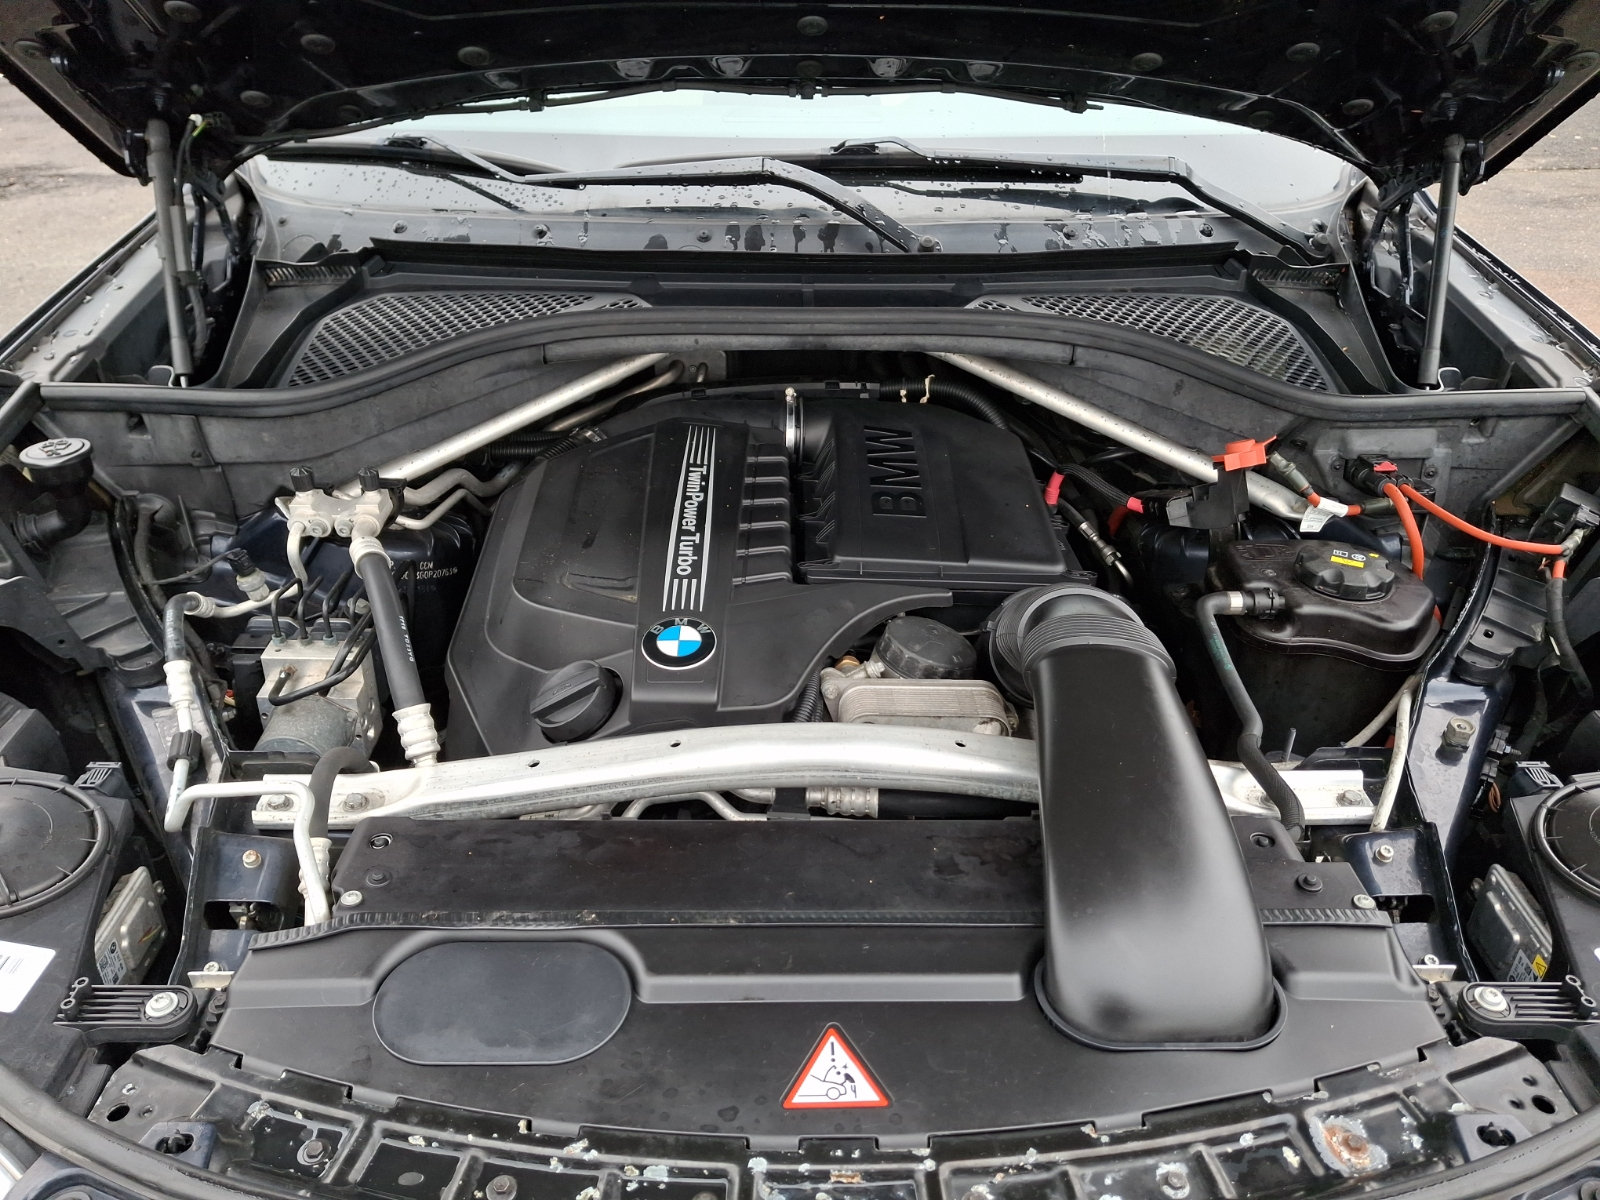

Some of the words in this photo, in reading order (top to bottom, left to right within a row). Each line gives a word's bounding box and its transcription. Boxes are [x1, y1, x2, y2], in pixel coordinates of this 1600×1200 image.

[681, 465, 707, 532] TwinPower
[863, 425, 927, 518] BMW
[676, 533, 700, 576] Turbo
[650, 617, 711, 634] BMW
